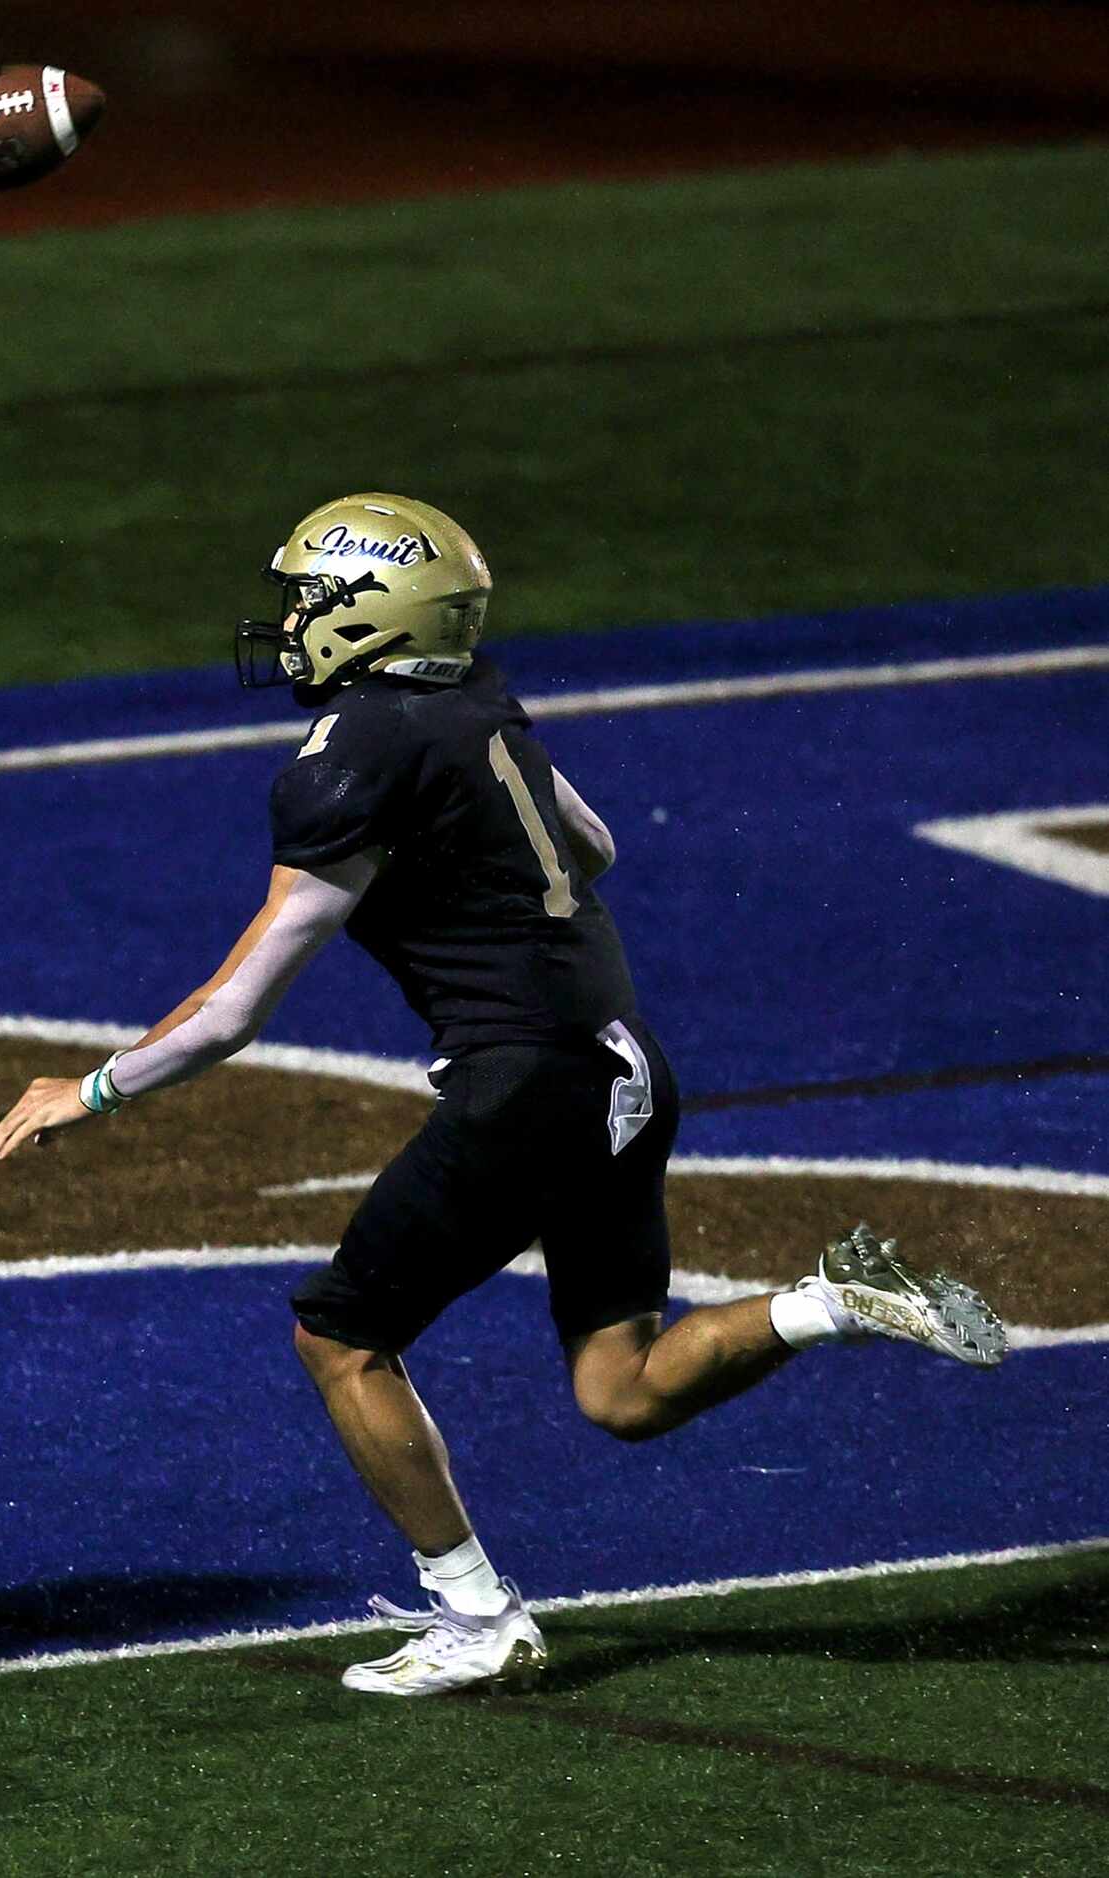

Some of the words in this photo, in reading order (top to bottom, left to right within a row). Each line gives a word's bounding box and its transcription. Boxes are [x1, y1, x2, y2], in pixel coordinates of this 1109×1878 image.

[315, 525, 417, 567] Jesuit
[296, 713, 341, 760] 1
[489, 729, 580, 918] 1
